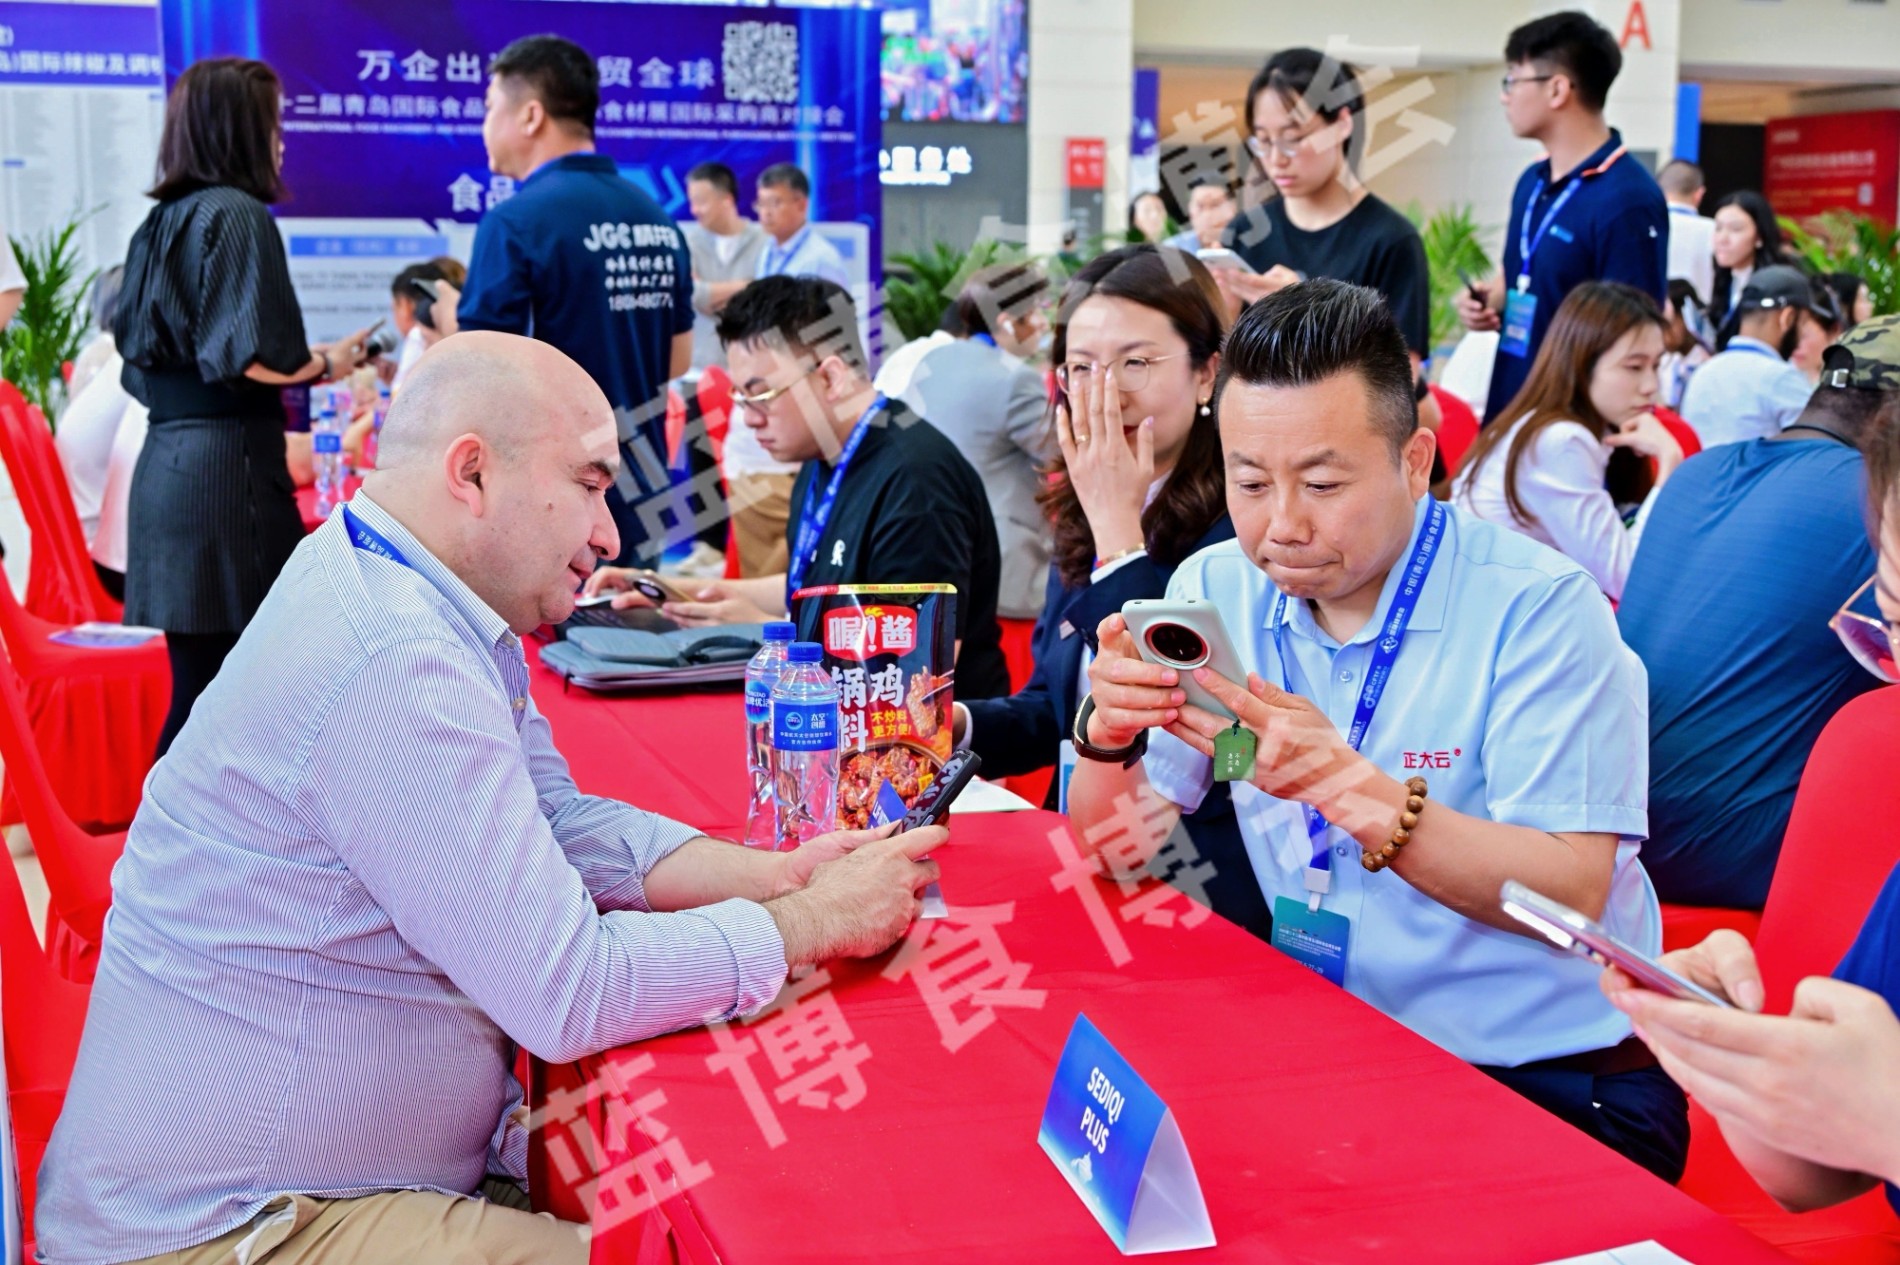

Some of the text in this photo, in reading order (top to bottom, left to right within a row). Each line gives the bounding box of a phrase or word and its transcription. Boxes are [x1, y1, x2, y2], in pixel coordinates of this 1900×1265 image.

[1620, 0, 1652, 50] A
[356, 49, 715, 89] 万企出 贸全球
[1403, 751, 1450, 769] 正大云
[1086, 1066, 1125, 1126] SEDIQI
[1080, 1105, 1110, 1154] PLUS
